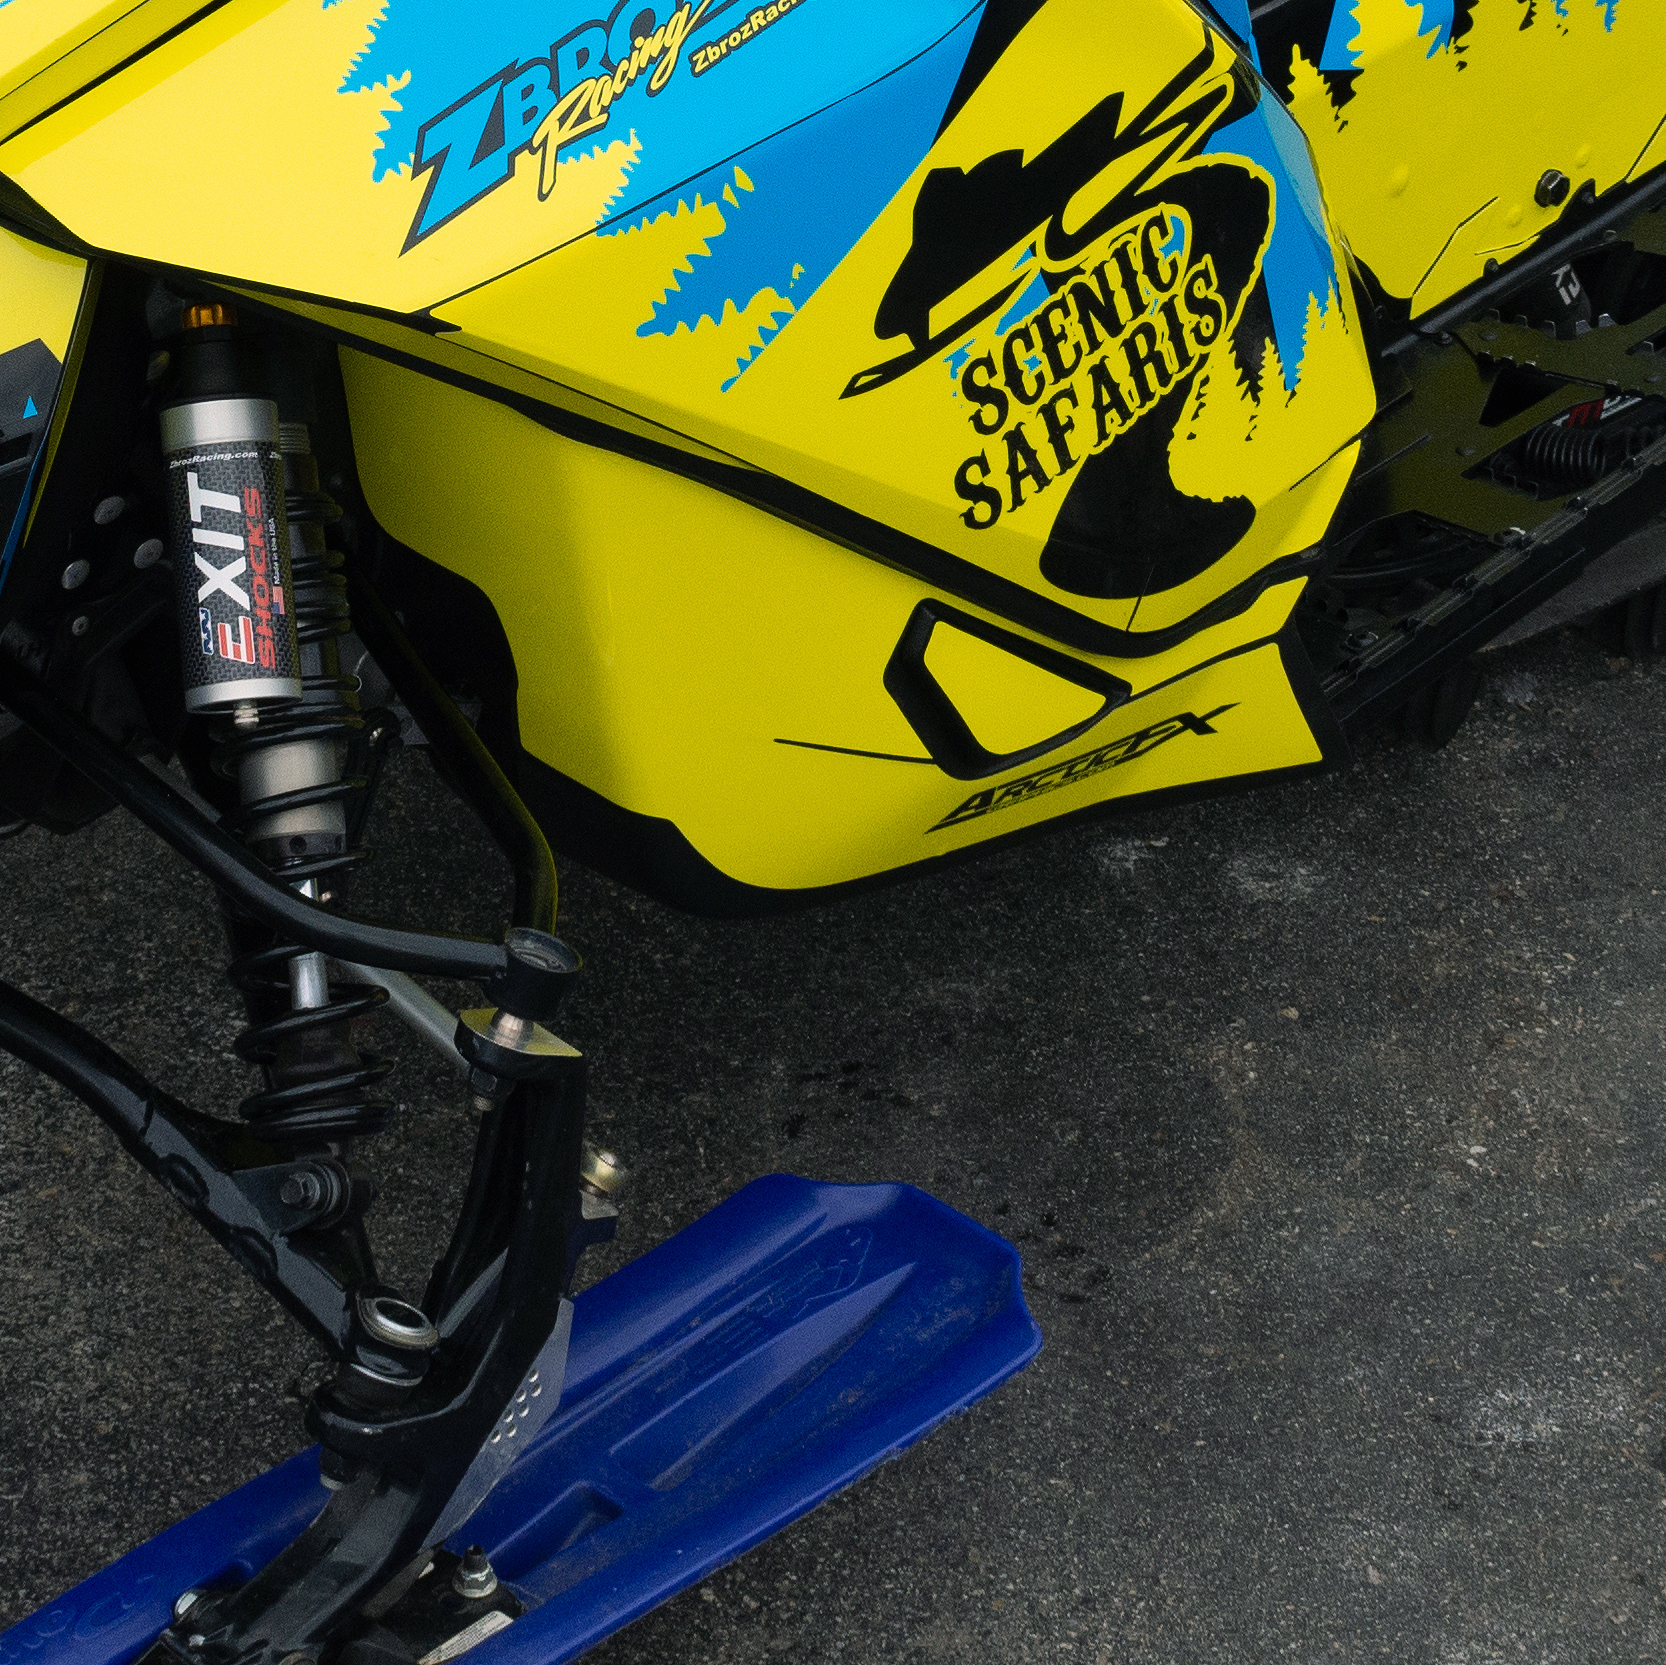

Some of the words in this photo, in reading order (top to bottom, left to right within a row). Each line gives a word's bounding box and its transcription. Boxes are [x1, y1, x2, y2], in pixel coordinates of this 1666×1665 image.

[954, 262, 1223, 529] SAFARIS
[961, 210, 1181, 435] SCENIC
[187, 471, 255, 665] EXIT
[244, 486, 276, 669] SHOCKS
